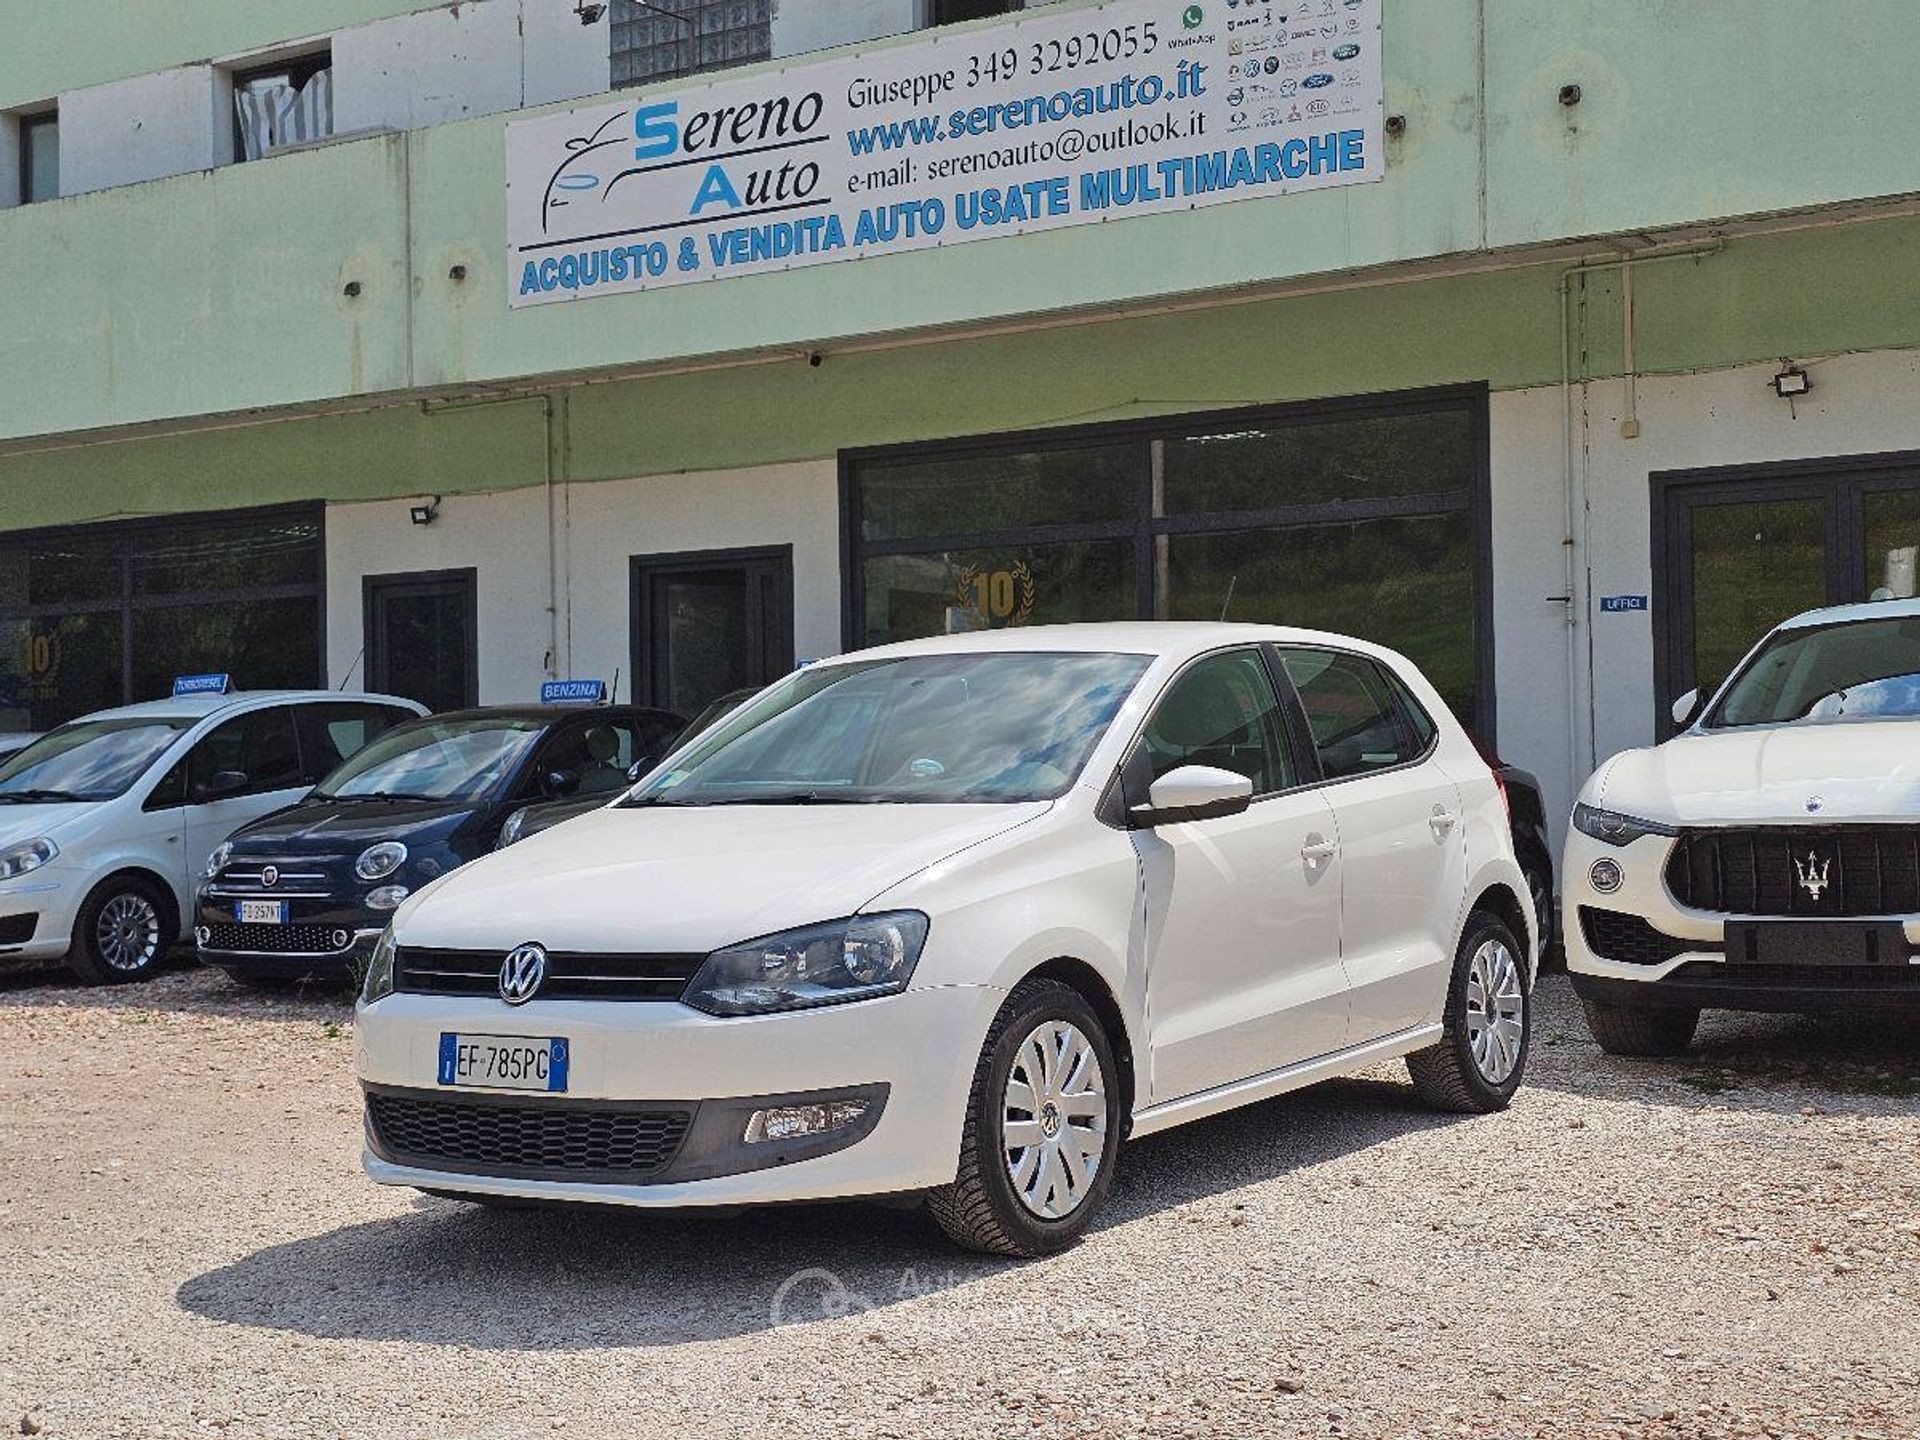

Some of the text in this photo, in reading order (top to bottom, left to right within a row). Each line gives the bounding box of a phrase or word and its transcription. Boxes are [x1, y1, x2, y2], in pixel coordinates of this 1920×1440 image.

[848, 21, 1158, 108] Giuseppe 349 3292055
[635, 92, 823, 160] Sereno
[847, 59, 1208, 156] www.serenoauto.it
[689, 159, 819, 215] Auto
[848, 110, 1206, 193] e-mail: serenoauto@outlook.it
[520, 129, 1364, 295] ACQUISTO & VENDITA AUTO USATE MULTIMARCHE
[1607, 598, 1640, 609] UFFICI
[545, 684, 596, 698] BENZINA
